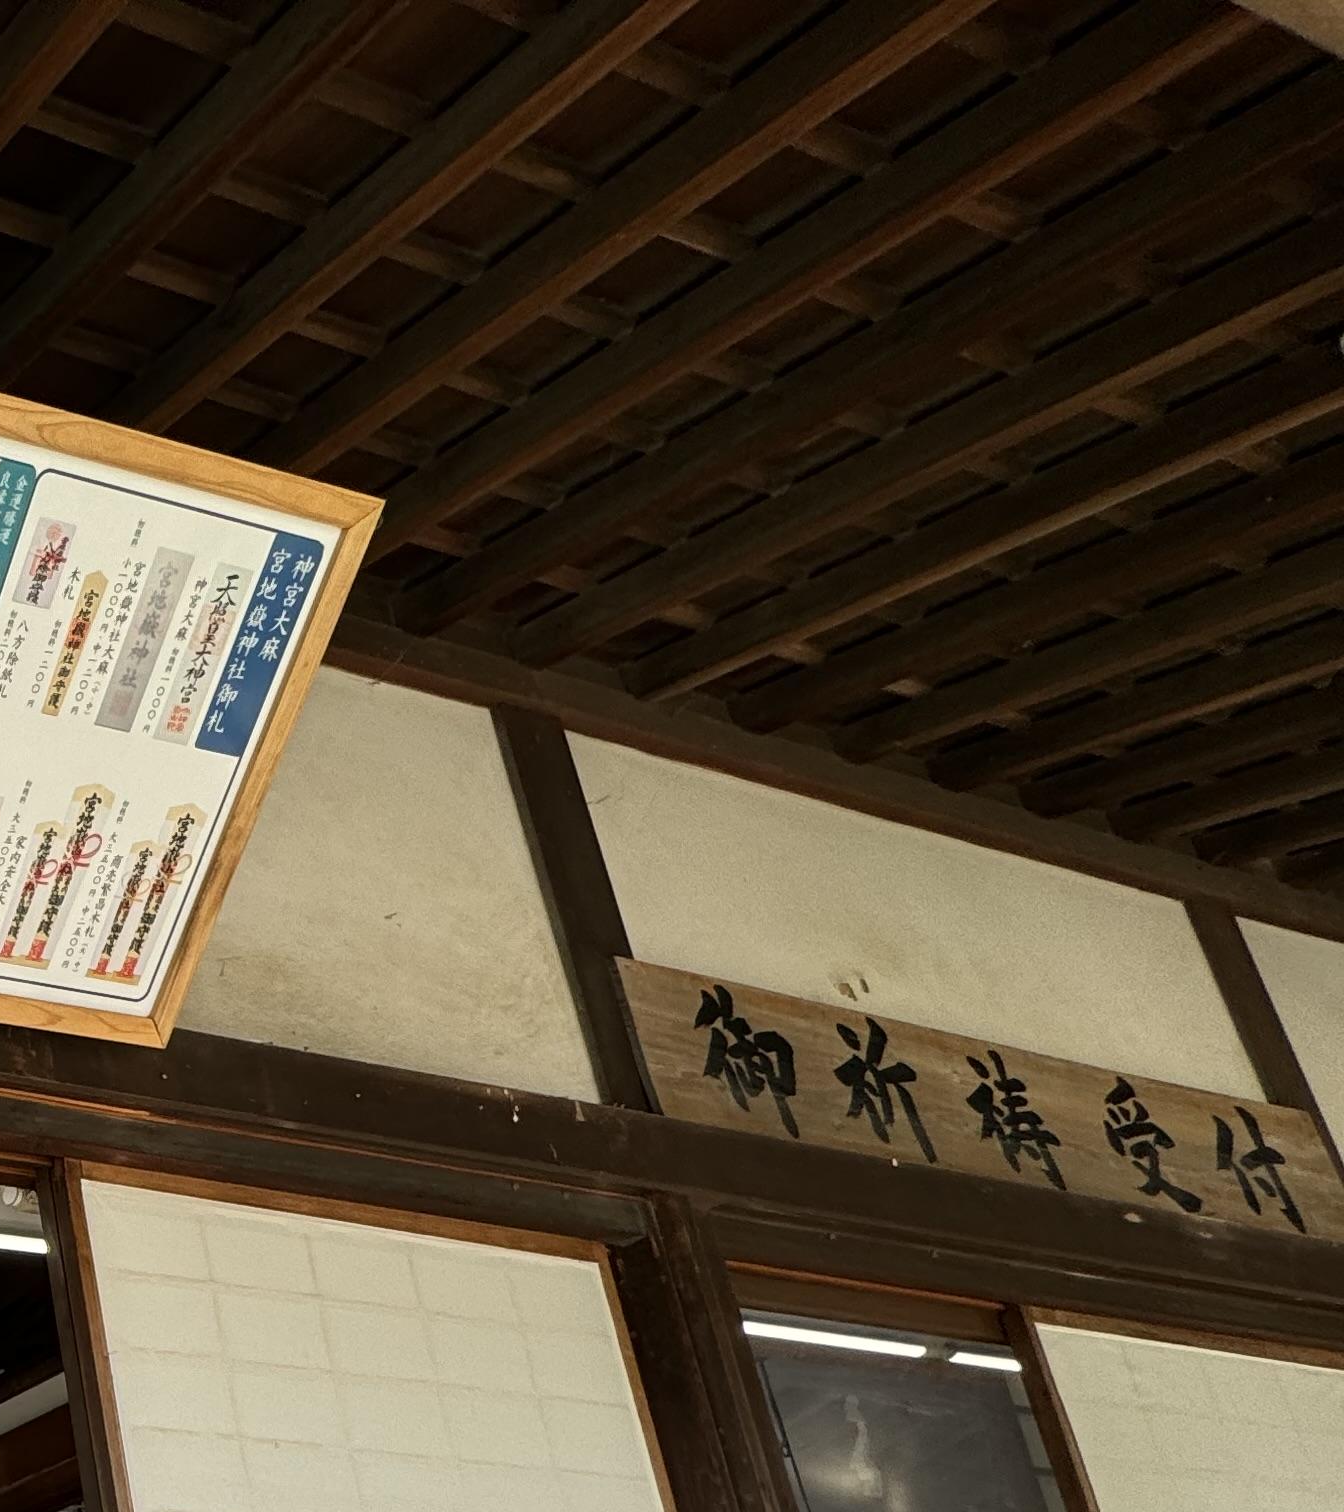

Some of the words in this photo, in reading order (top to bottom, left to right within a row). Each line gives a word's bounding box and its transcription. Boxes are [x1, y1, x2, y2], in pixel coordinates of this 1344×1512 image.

[64, 566, 81, 601] 木札
[120, 562, 180, 689] 宮地嶽神社
[175, 577, 208, 641] 神宮大麻
[258, 553, 315, 662] 神宮大麻
[207, 549, 291, 734] 宮地嶽神社御札
